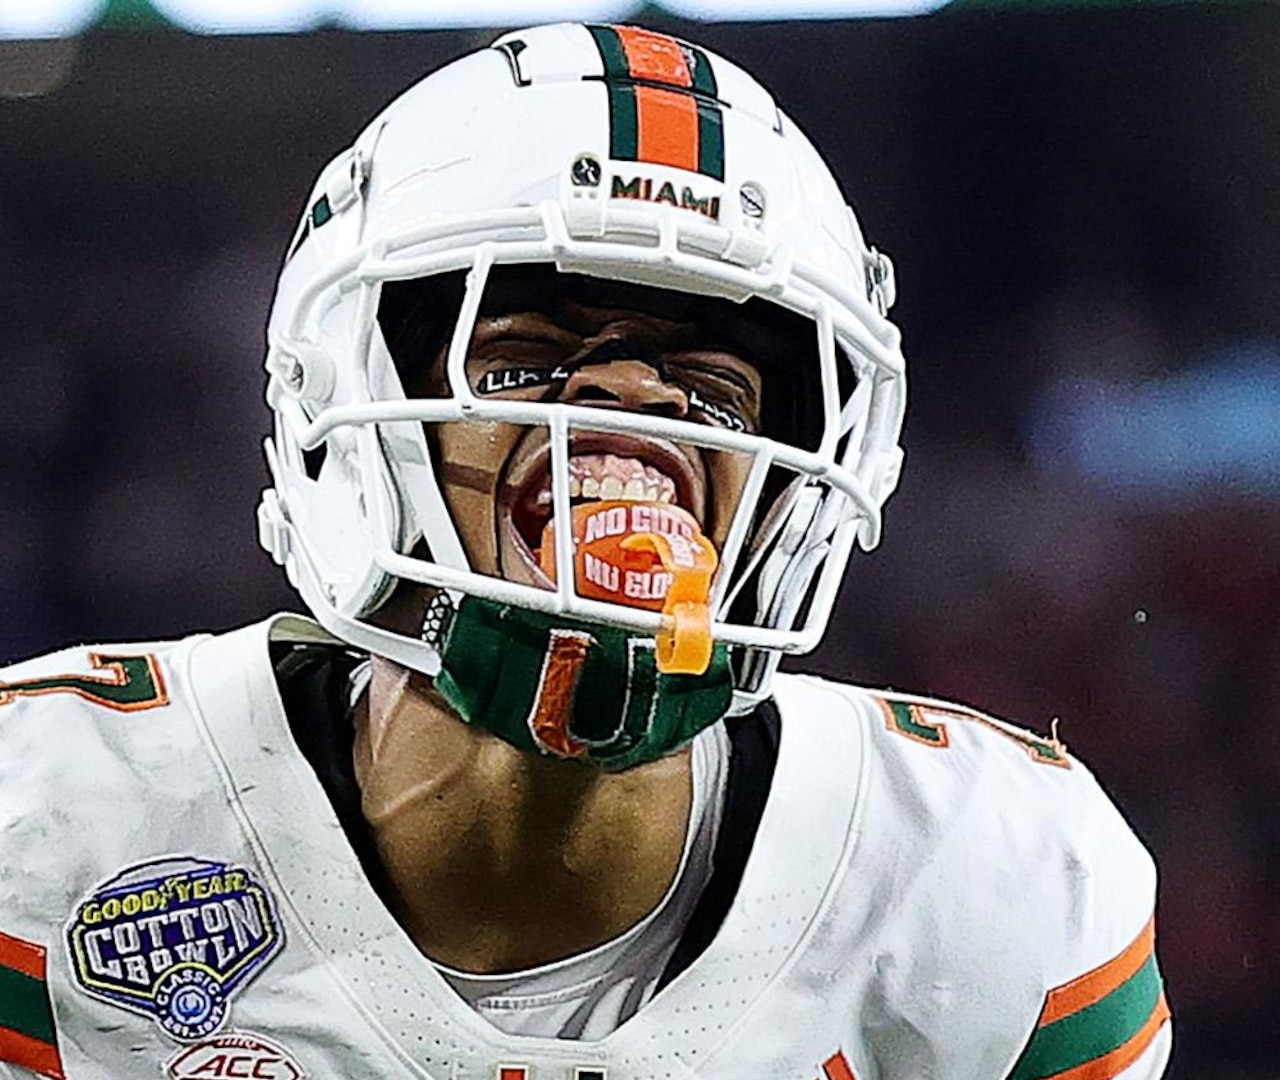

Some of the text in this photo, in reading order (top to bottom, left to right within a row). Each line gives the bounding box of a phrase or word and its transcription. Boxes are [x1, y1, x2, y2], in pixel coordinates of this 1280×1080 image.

[610, 175, 721, 222] MIAMI
[584, 506, 627, 544] NO
[624, 570, 674, 599] GLO
[82, 872, 246, 924] GOODYEAR
[84, 894, 264, 979] COTTON
[122, 935, 237, 986] BOWL
[156, 969, 221, 1006] CLASSIC
